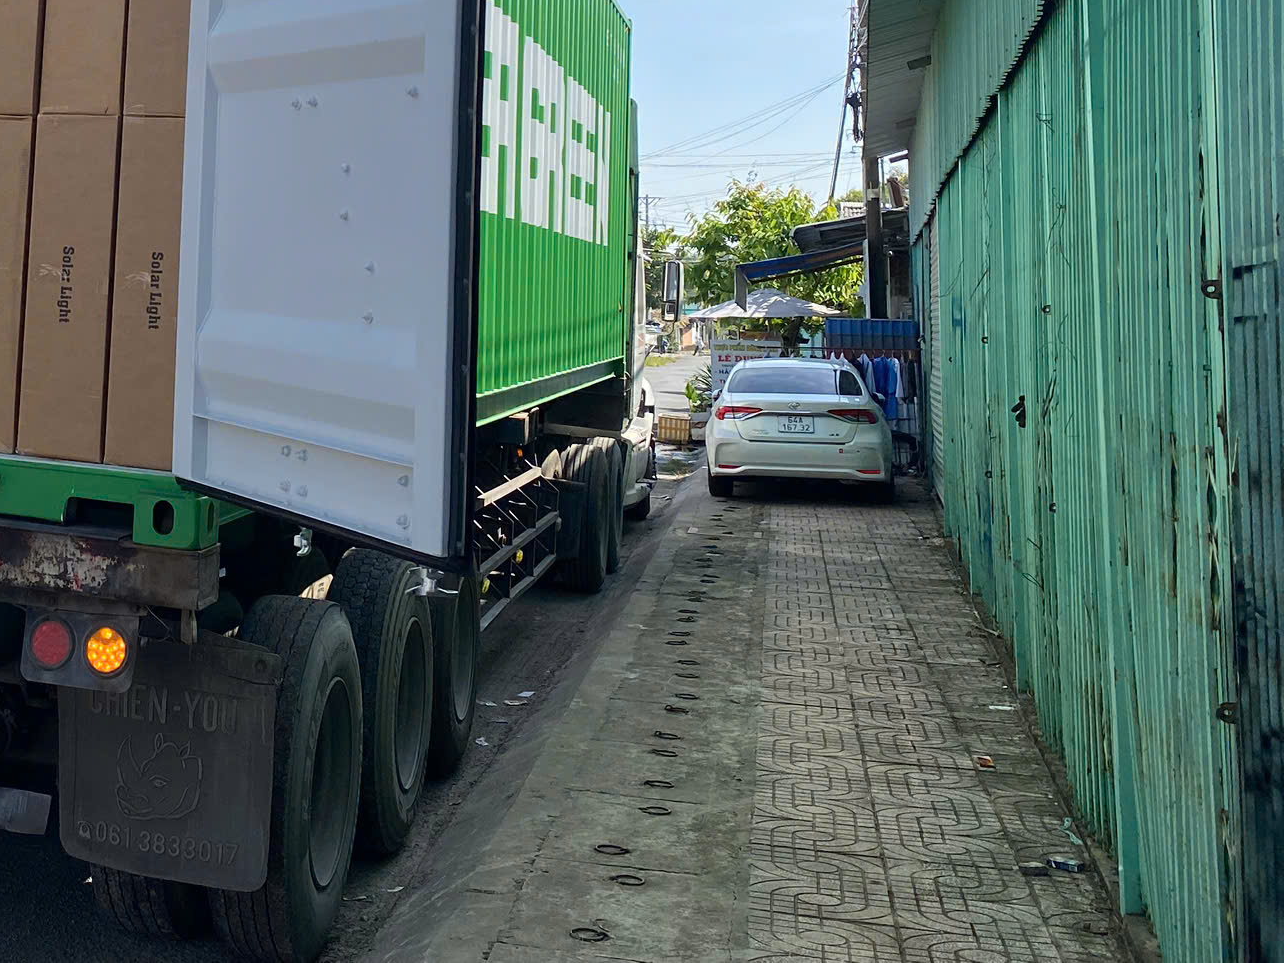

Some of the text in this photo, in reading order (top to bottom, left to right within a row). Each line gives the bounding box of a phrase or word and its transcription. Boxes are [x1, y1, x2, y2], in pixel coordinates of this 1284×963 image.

[56, 246, 75, 323] Solar Light
[146, 251, 164, 330] Solar Light
